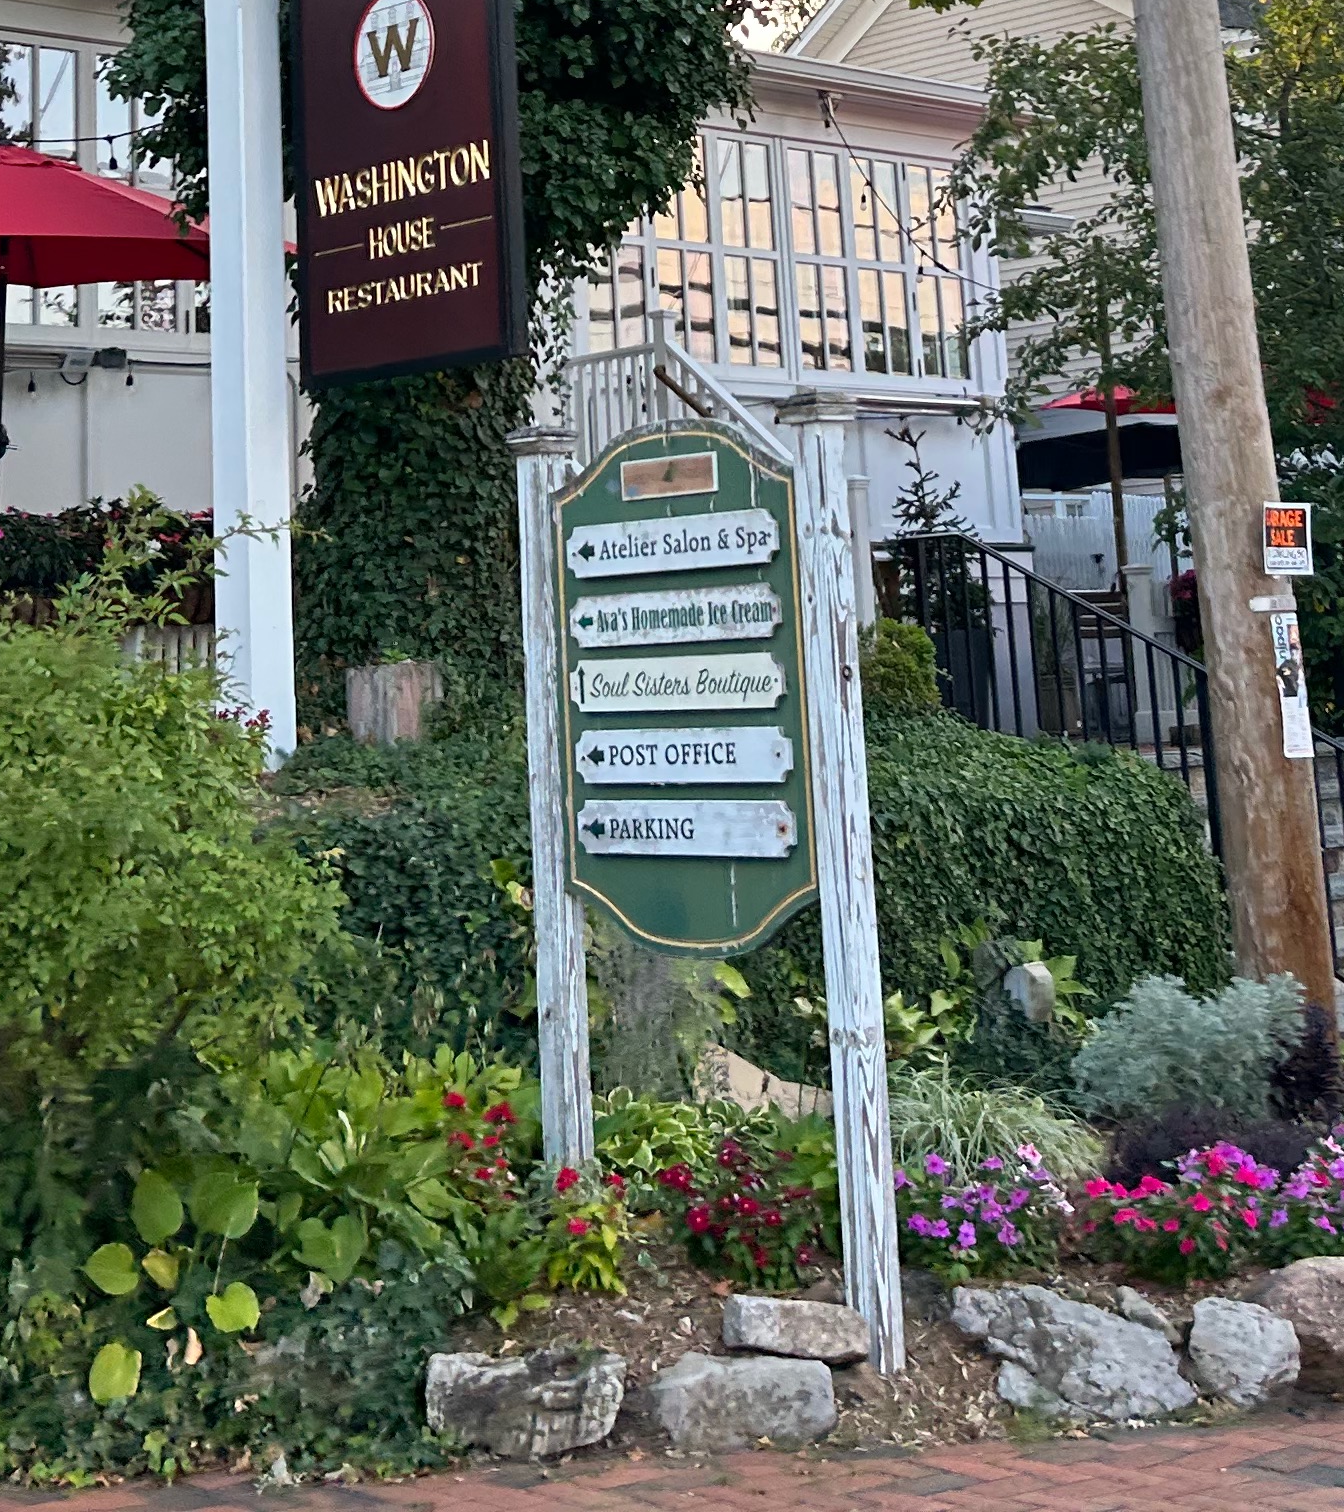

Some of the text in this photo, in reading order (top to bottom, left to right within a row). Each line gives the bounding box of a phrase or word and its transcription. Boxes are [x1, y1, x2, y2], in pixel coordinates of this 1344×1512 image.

[367, 18, 419, 78] W
[314, 139, 491, 218] WASHINGTON
[368, 216, 437, 260] HOUSE
[327, 261, 483, 315] RESTAURANT
[599, 526, 768, 561] Atelier Salon & Spa
[1270, 529, 1295, 546] SALE
[596, 599, 773, 633] Ava's Homemade Ice Cream
[590, 669, 773, 702] Soul Sisters Boutique
[608, 742, 737, 766] POST OFFICE
[609, 818, 695, 840] PARKING
